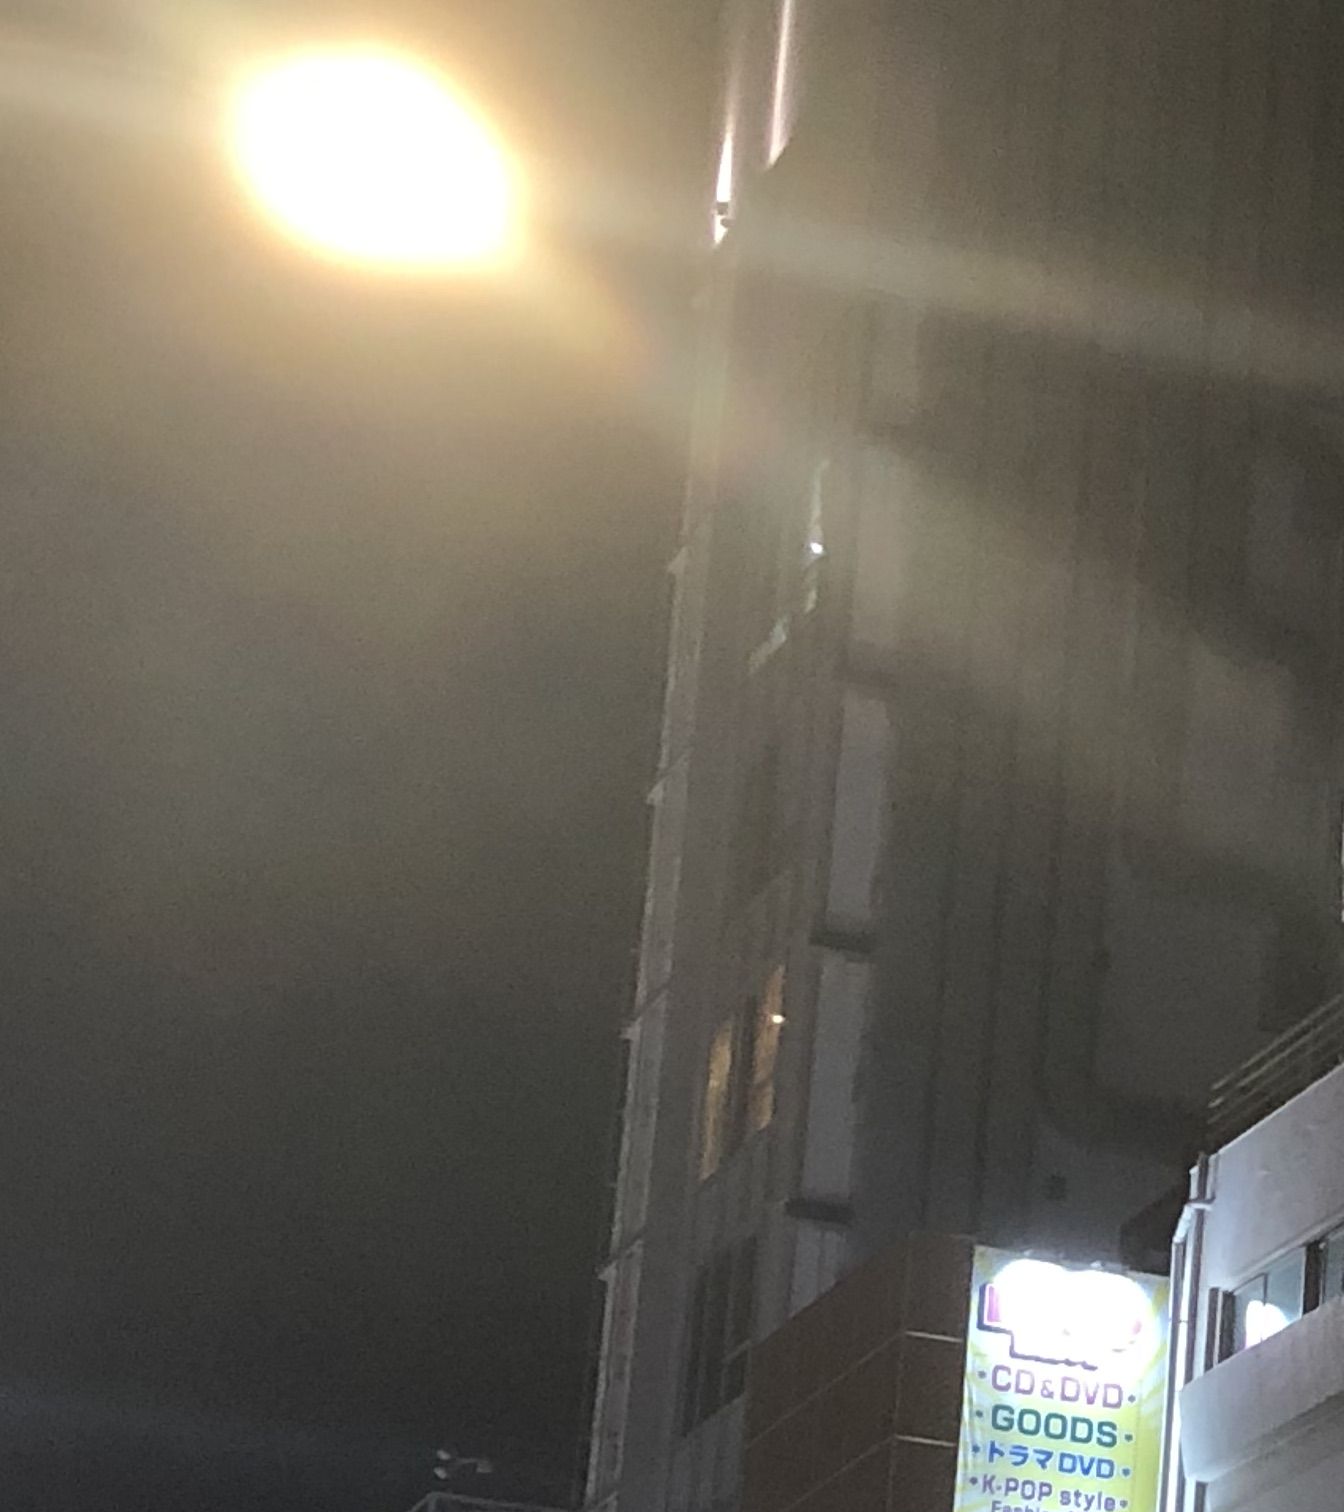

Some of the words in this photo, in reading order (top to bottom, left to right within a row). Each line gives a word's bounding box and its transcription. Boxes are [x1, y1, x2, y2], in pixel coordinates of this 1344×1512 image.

[991, 1404, 1119, 1448] GOODS
[982, 1474, 1053, 1502] K-POP
[1059, 1489, 1116, 1512] style
